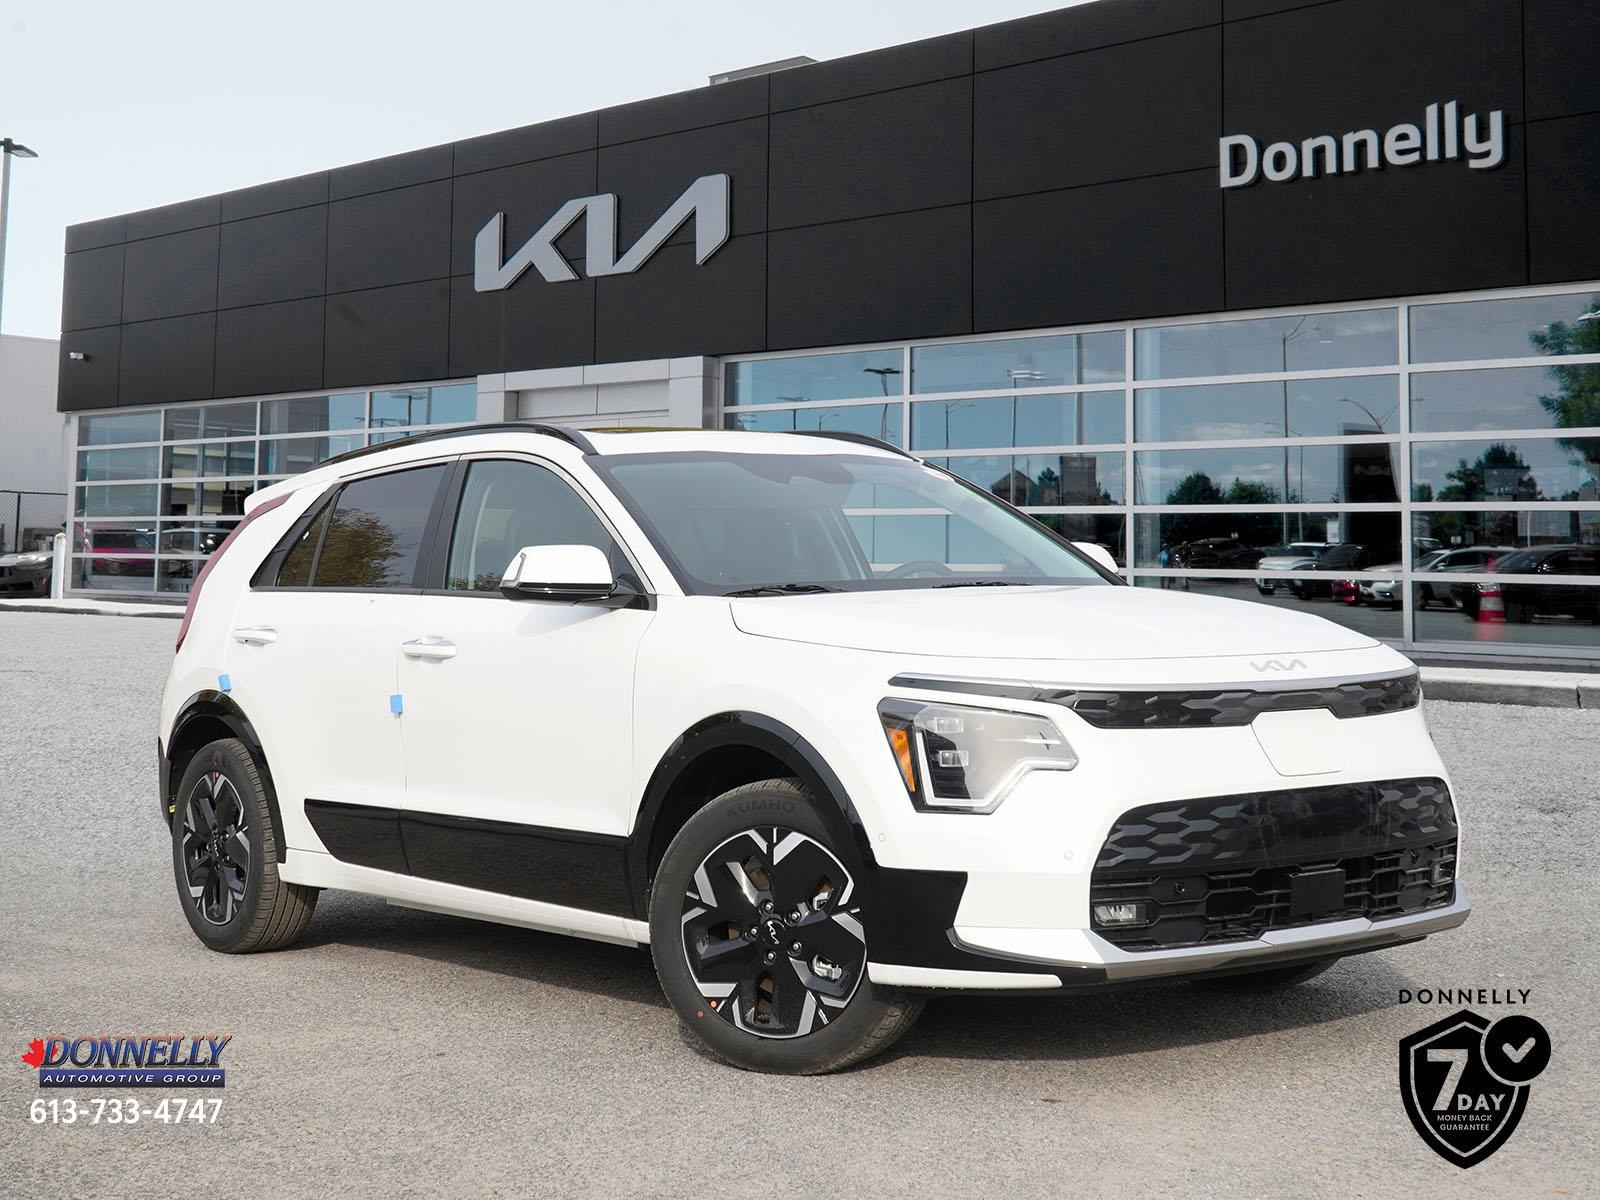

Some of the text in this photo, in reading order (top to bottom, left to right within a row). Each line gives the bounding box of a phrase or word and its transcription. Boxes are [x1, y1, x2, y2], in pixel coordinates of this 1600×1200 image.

[1219, 100, 1503, 188] Donnelly
[474, 173, 731, 292] KIA
[726, 800, 796, 818] KUMHO
